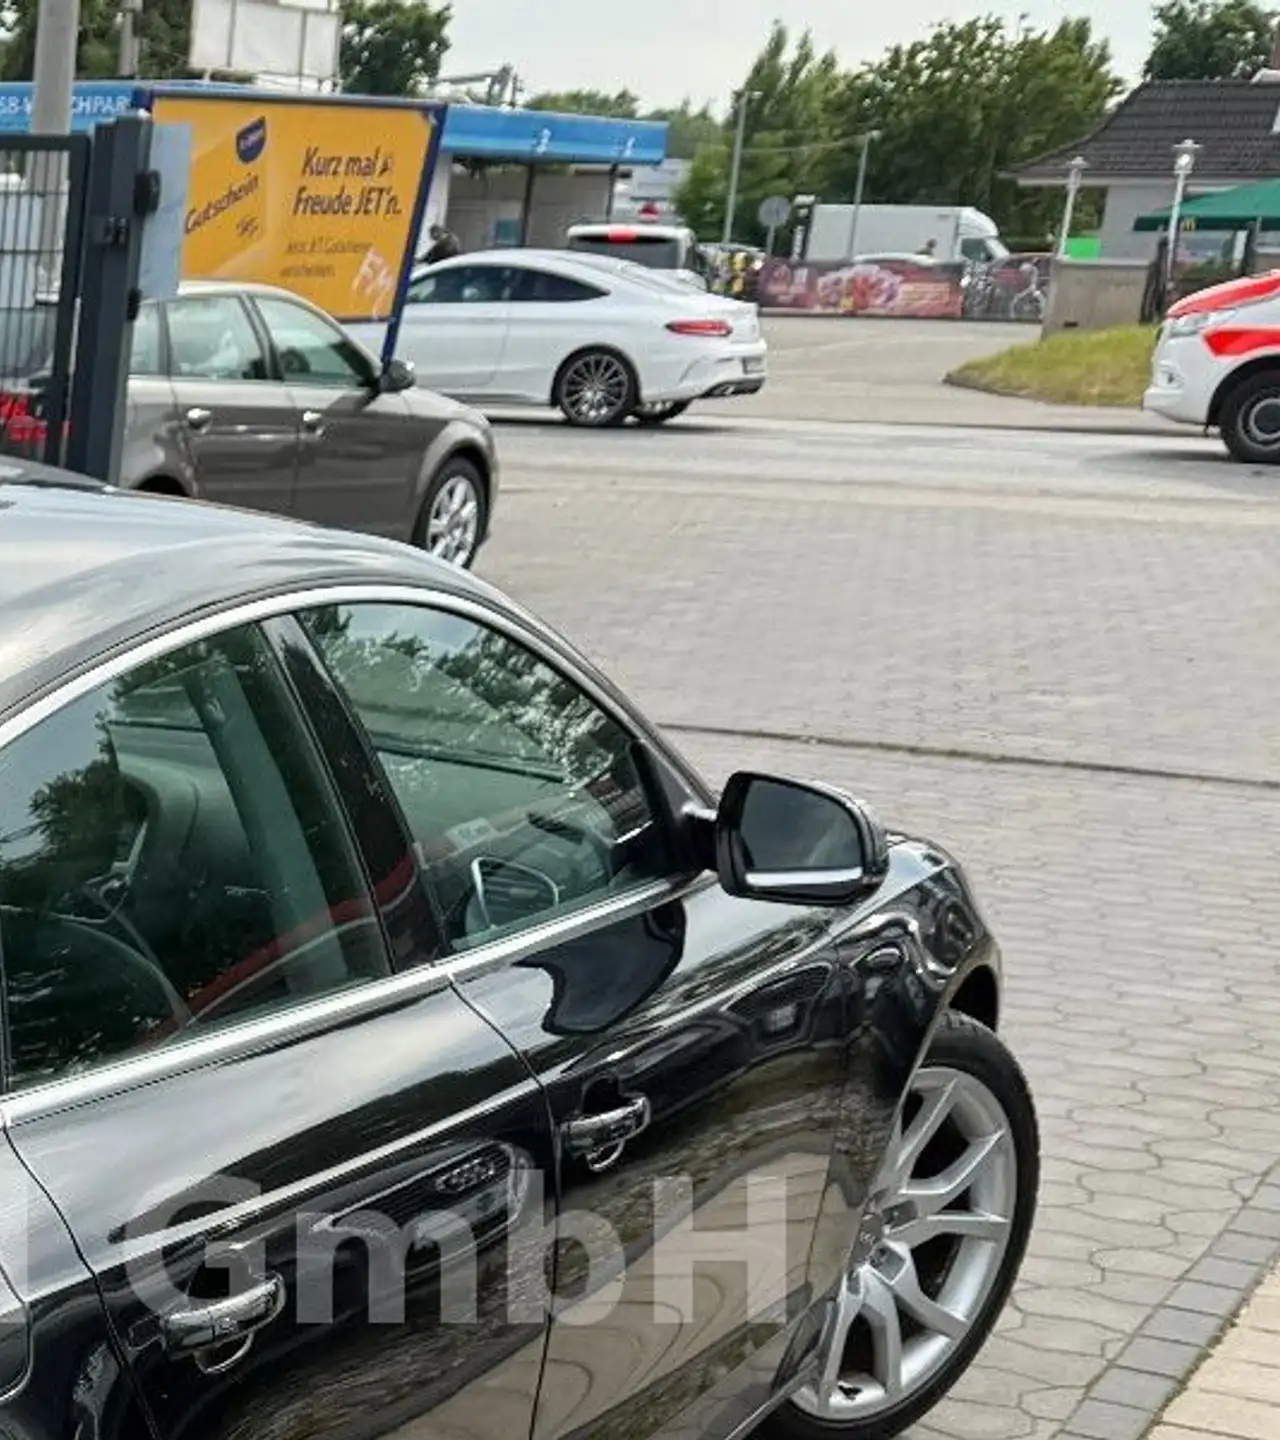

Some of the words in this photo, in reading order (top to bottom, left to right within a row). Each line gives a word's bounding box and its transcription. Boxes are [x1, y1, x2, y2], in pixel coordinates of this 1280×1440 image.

[301, 147, 343, 176] Kurz
[344, 145, 380, 176] mal
[184, 172, 260, 234] Gutschein
[292, 185, 351, 216] Freude
